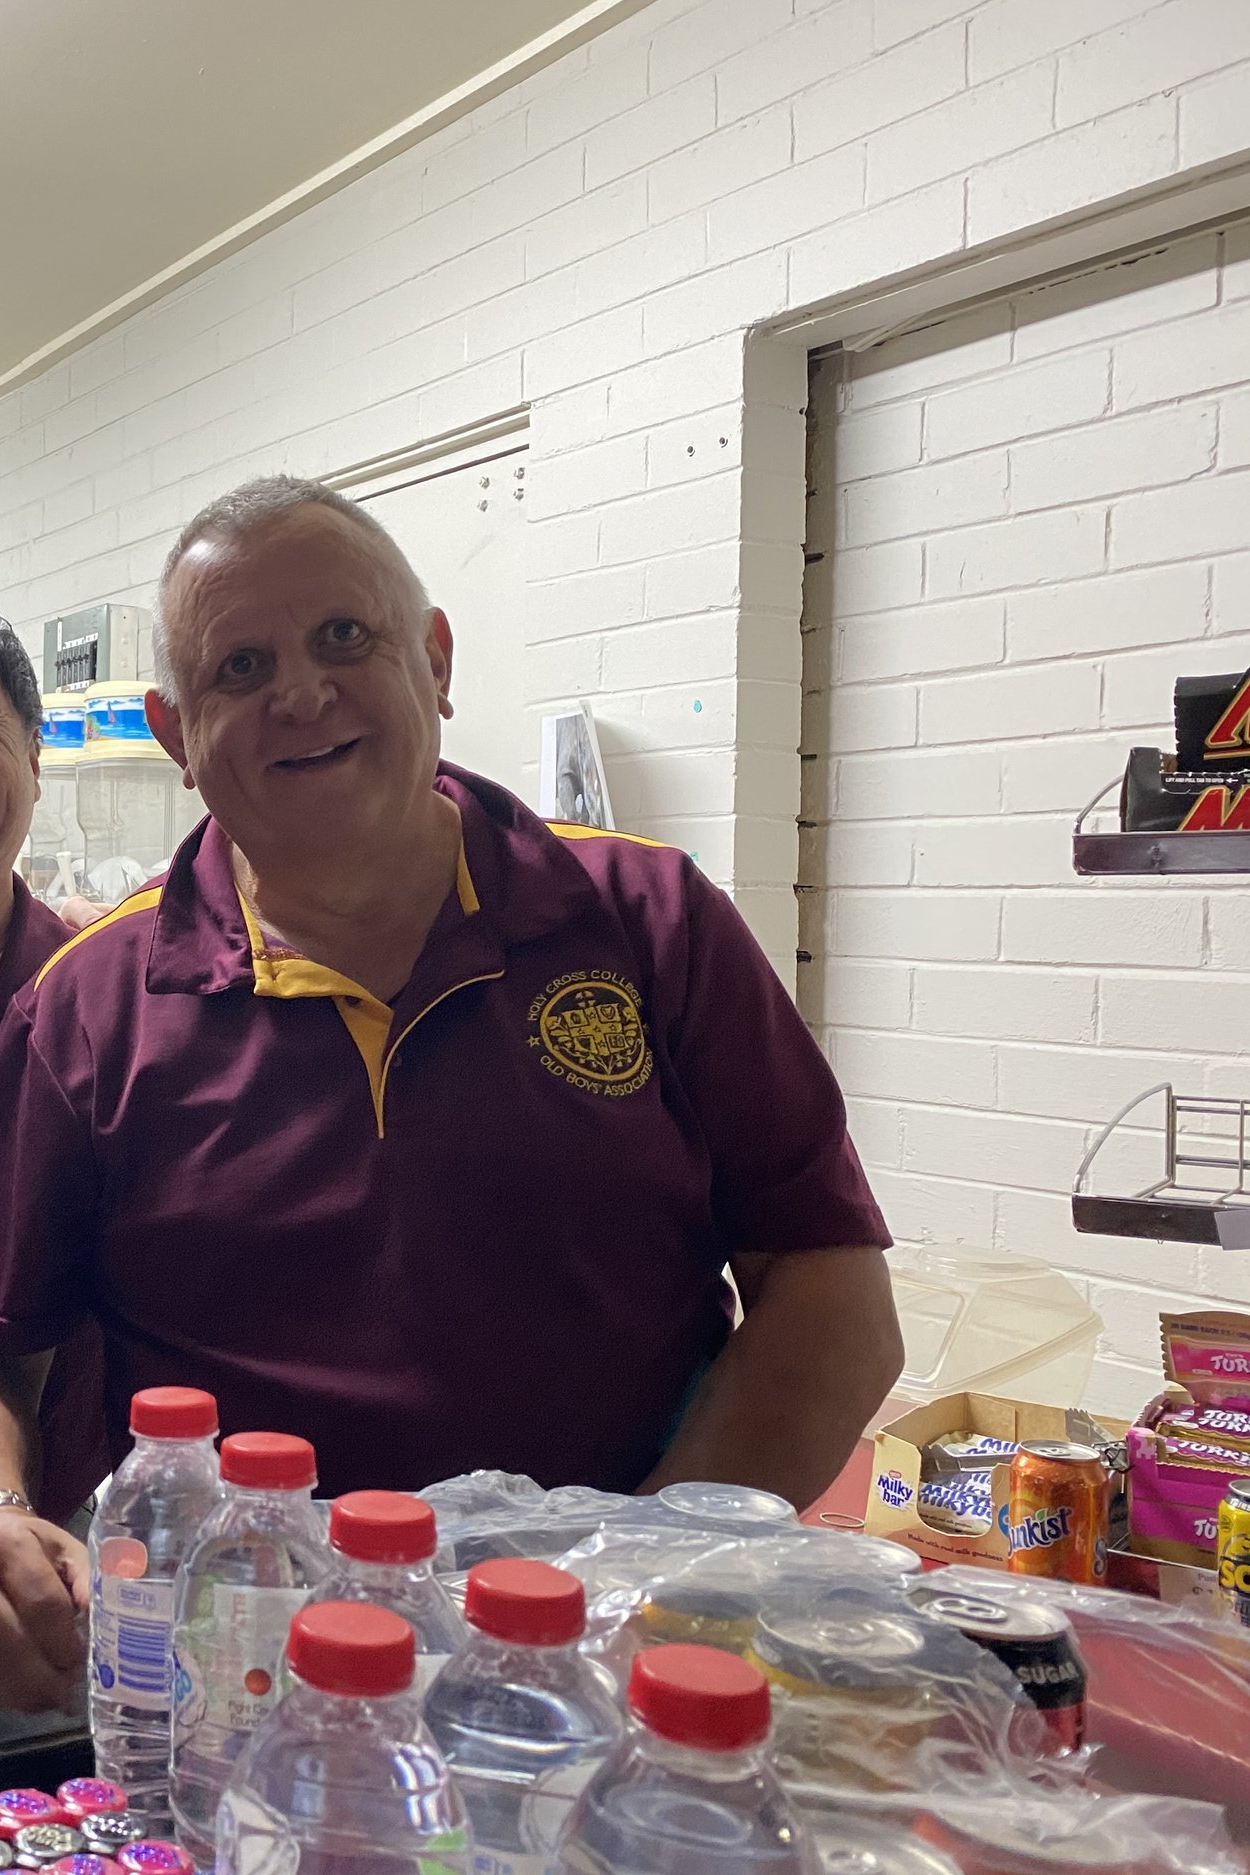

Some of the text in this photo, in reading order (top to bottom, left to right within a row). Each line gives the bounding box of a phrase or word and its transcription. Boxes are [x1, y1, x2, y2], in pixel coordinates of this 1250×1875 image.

[527, 969, 643, 1021] HOLY CROSS COLLEGE
[540, 1055, 565, 1076] OLD
[877, 1475, 913, 1501] Milky
[883, 1489, 905, 1507] bar
